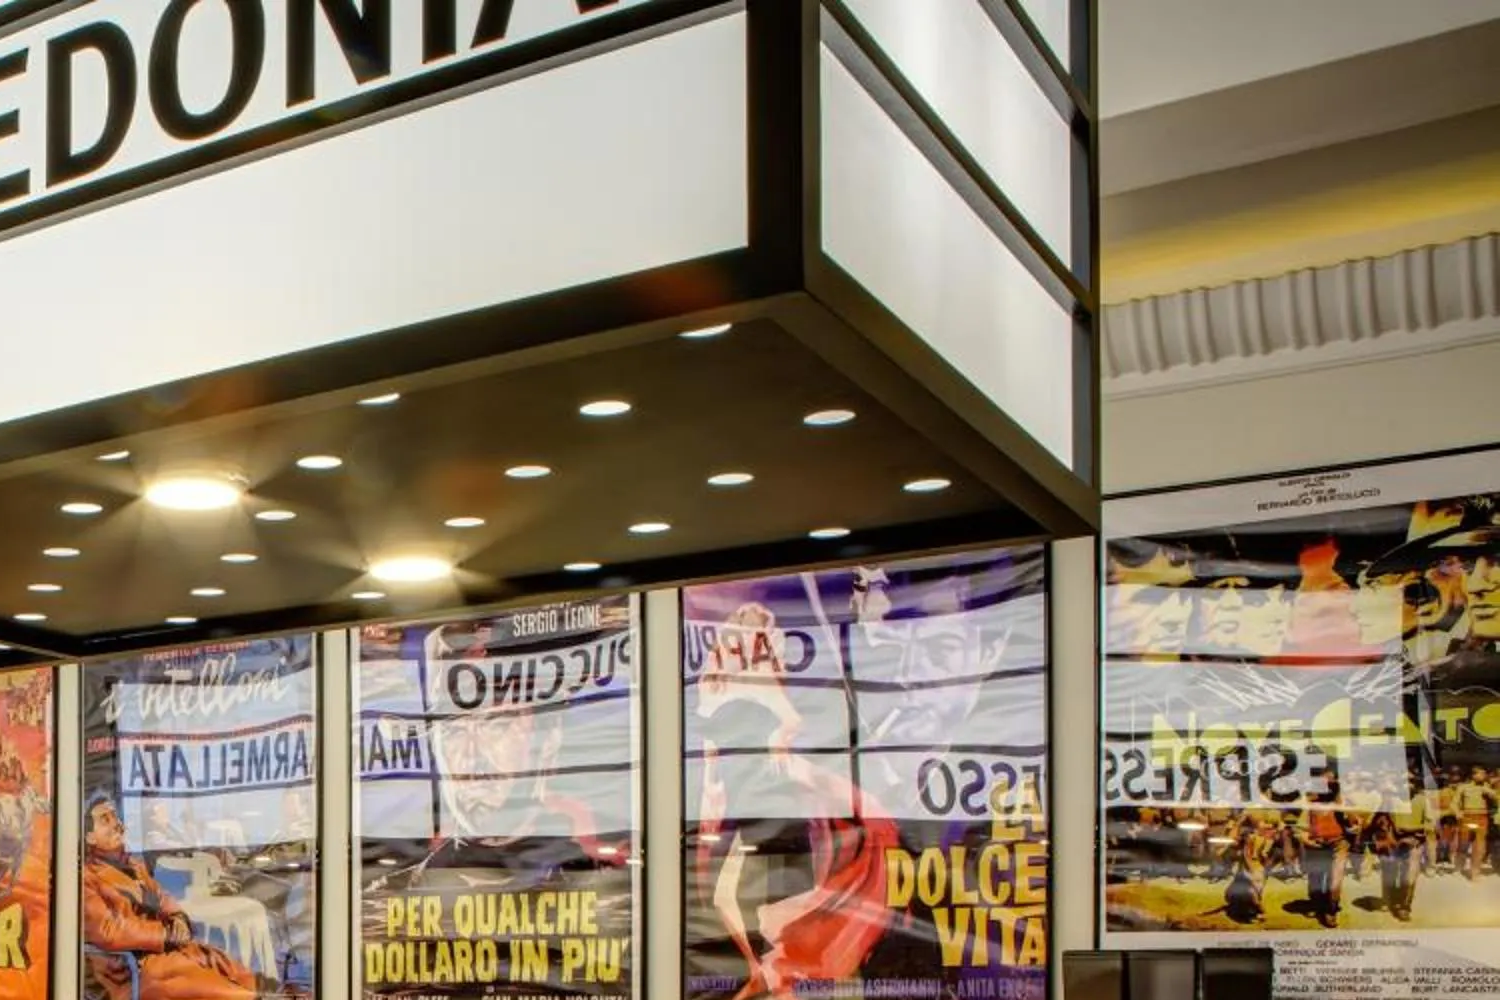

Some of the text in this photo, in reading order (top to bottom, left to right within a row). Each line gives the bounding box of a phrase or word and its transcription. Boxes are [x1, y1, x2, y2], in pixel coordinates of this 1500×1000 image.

[513, 603, 601, 637] SERGIO LEONE
[886, 841, 1047, 908] DOLCE
[387, 891, 598, 937] PER QUALCHE
[932, 904, 1047, 967] VITA
[365, 939, 497, 984] DOLLARO
[510, 938, 548, 982] IN
